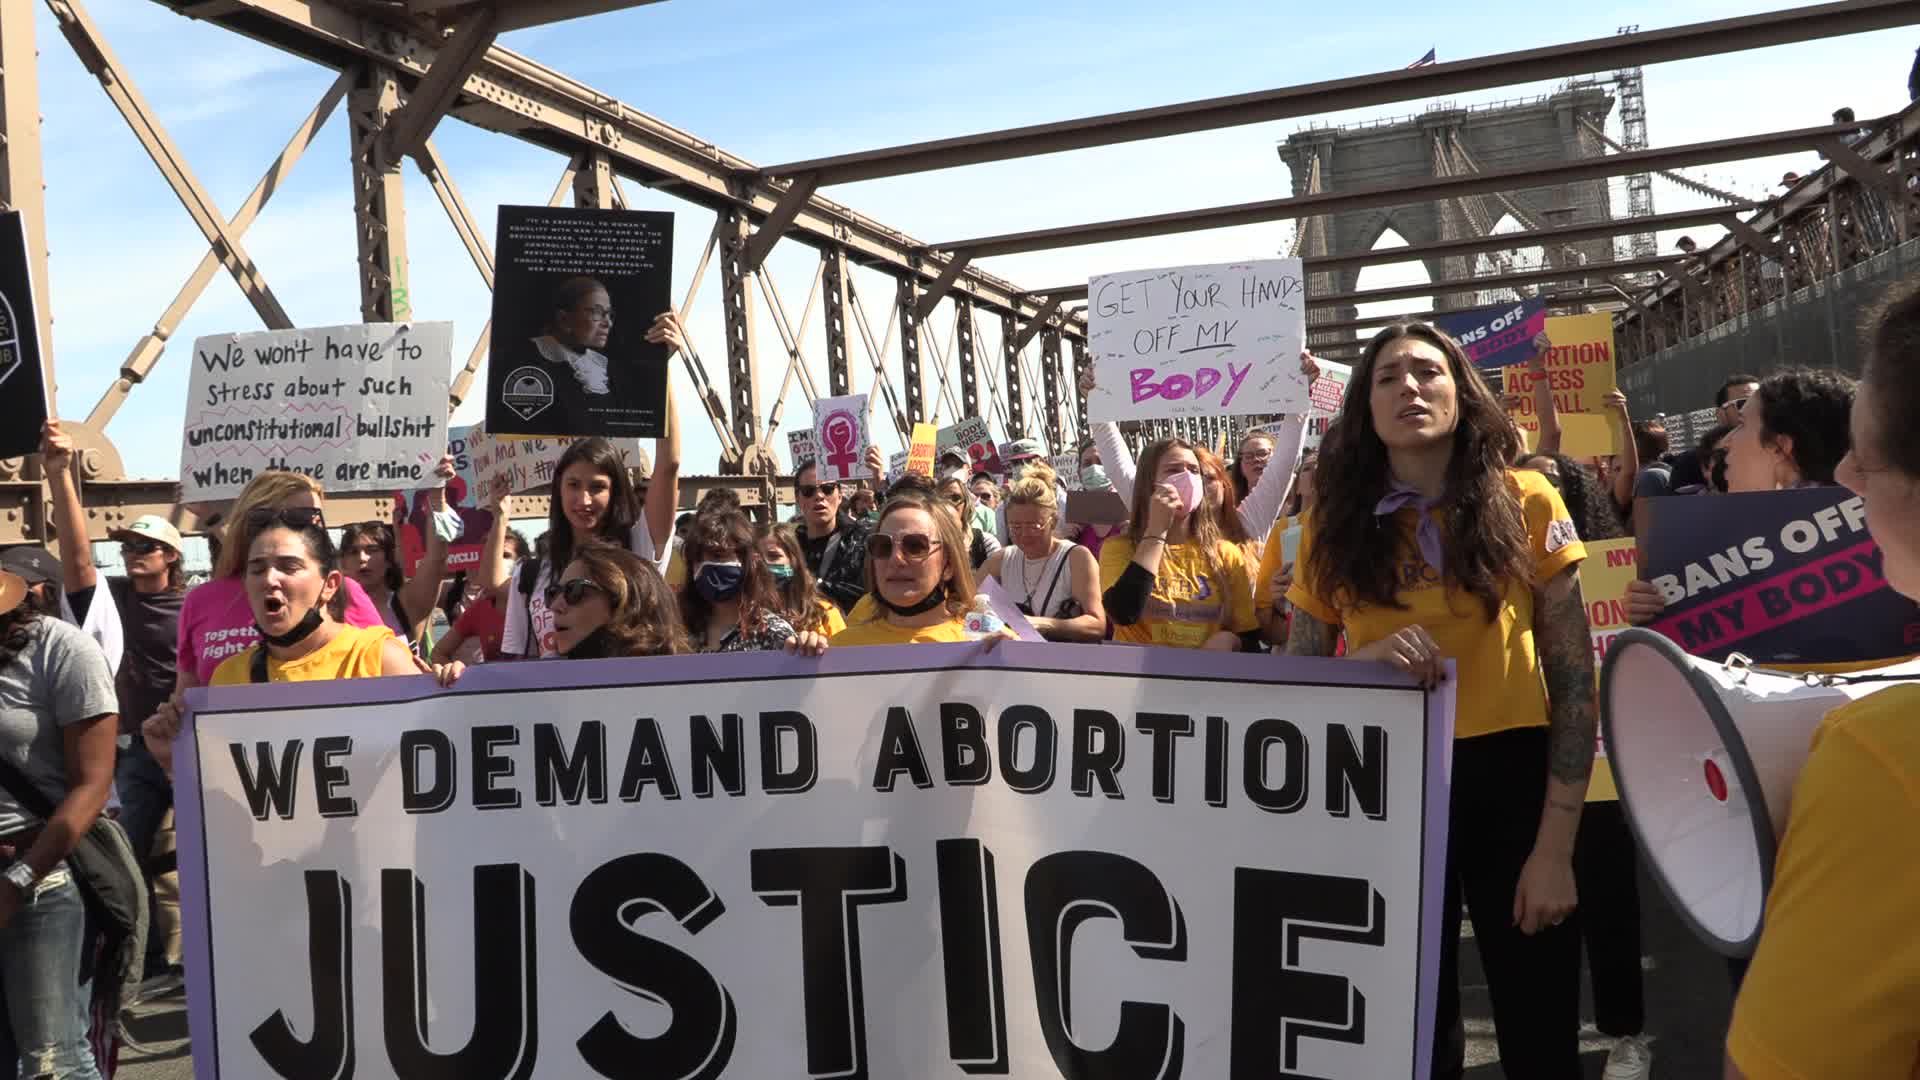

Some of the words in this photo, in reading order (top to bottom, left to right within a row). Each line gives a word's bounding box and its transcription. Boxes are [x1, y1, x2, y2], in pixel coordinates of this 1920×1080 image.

[1096, 278, 1154, 318] GET
[1170, 276, 1229, 314] YOUR
[1242, 275, 1304, 309] HANDS
[1133, 323, 1181, 355] OFF
[1196, 320, 1239, 348] MY
[1451, 326, 1488, 346] ANS
[1490, 305, 1524, 332] OFF
[200, 343, 246, 373] We
[254, 338, 314, 366] won't
[326, 335, 383, 361] have
[397, 338, 422, 360] to
[284, 375, 346, 398] about
[1130, 362, 1253, 407] BODY
[1508, 369, 1585, 393] ACESS
[189, 415, 342, 447] unconstitutional
[357, 413, 436, 438] bullshit
[956, 421, 982, 440] BODY
[335, 462, 370, 481] are
[1650, 536, 1775, 607] BANS
[1779, 496, 1866, 553] OFF
[1677, 599, 1747, 651] MY
[1756, 544, 1885, 620] BODY
[230, 735, 359, 821] WE
[400, 709, 818, 816] DEMAND
[872, 702, 1388, 822] ABORTION
[248, 837, 1386, 1080] JUSTICE
